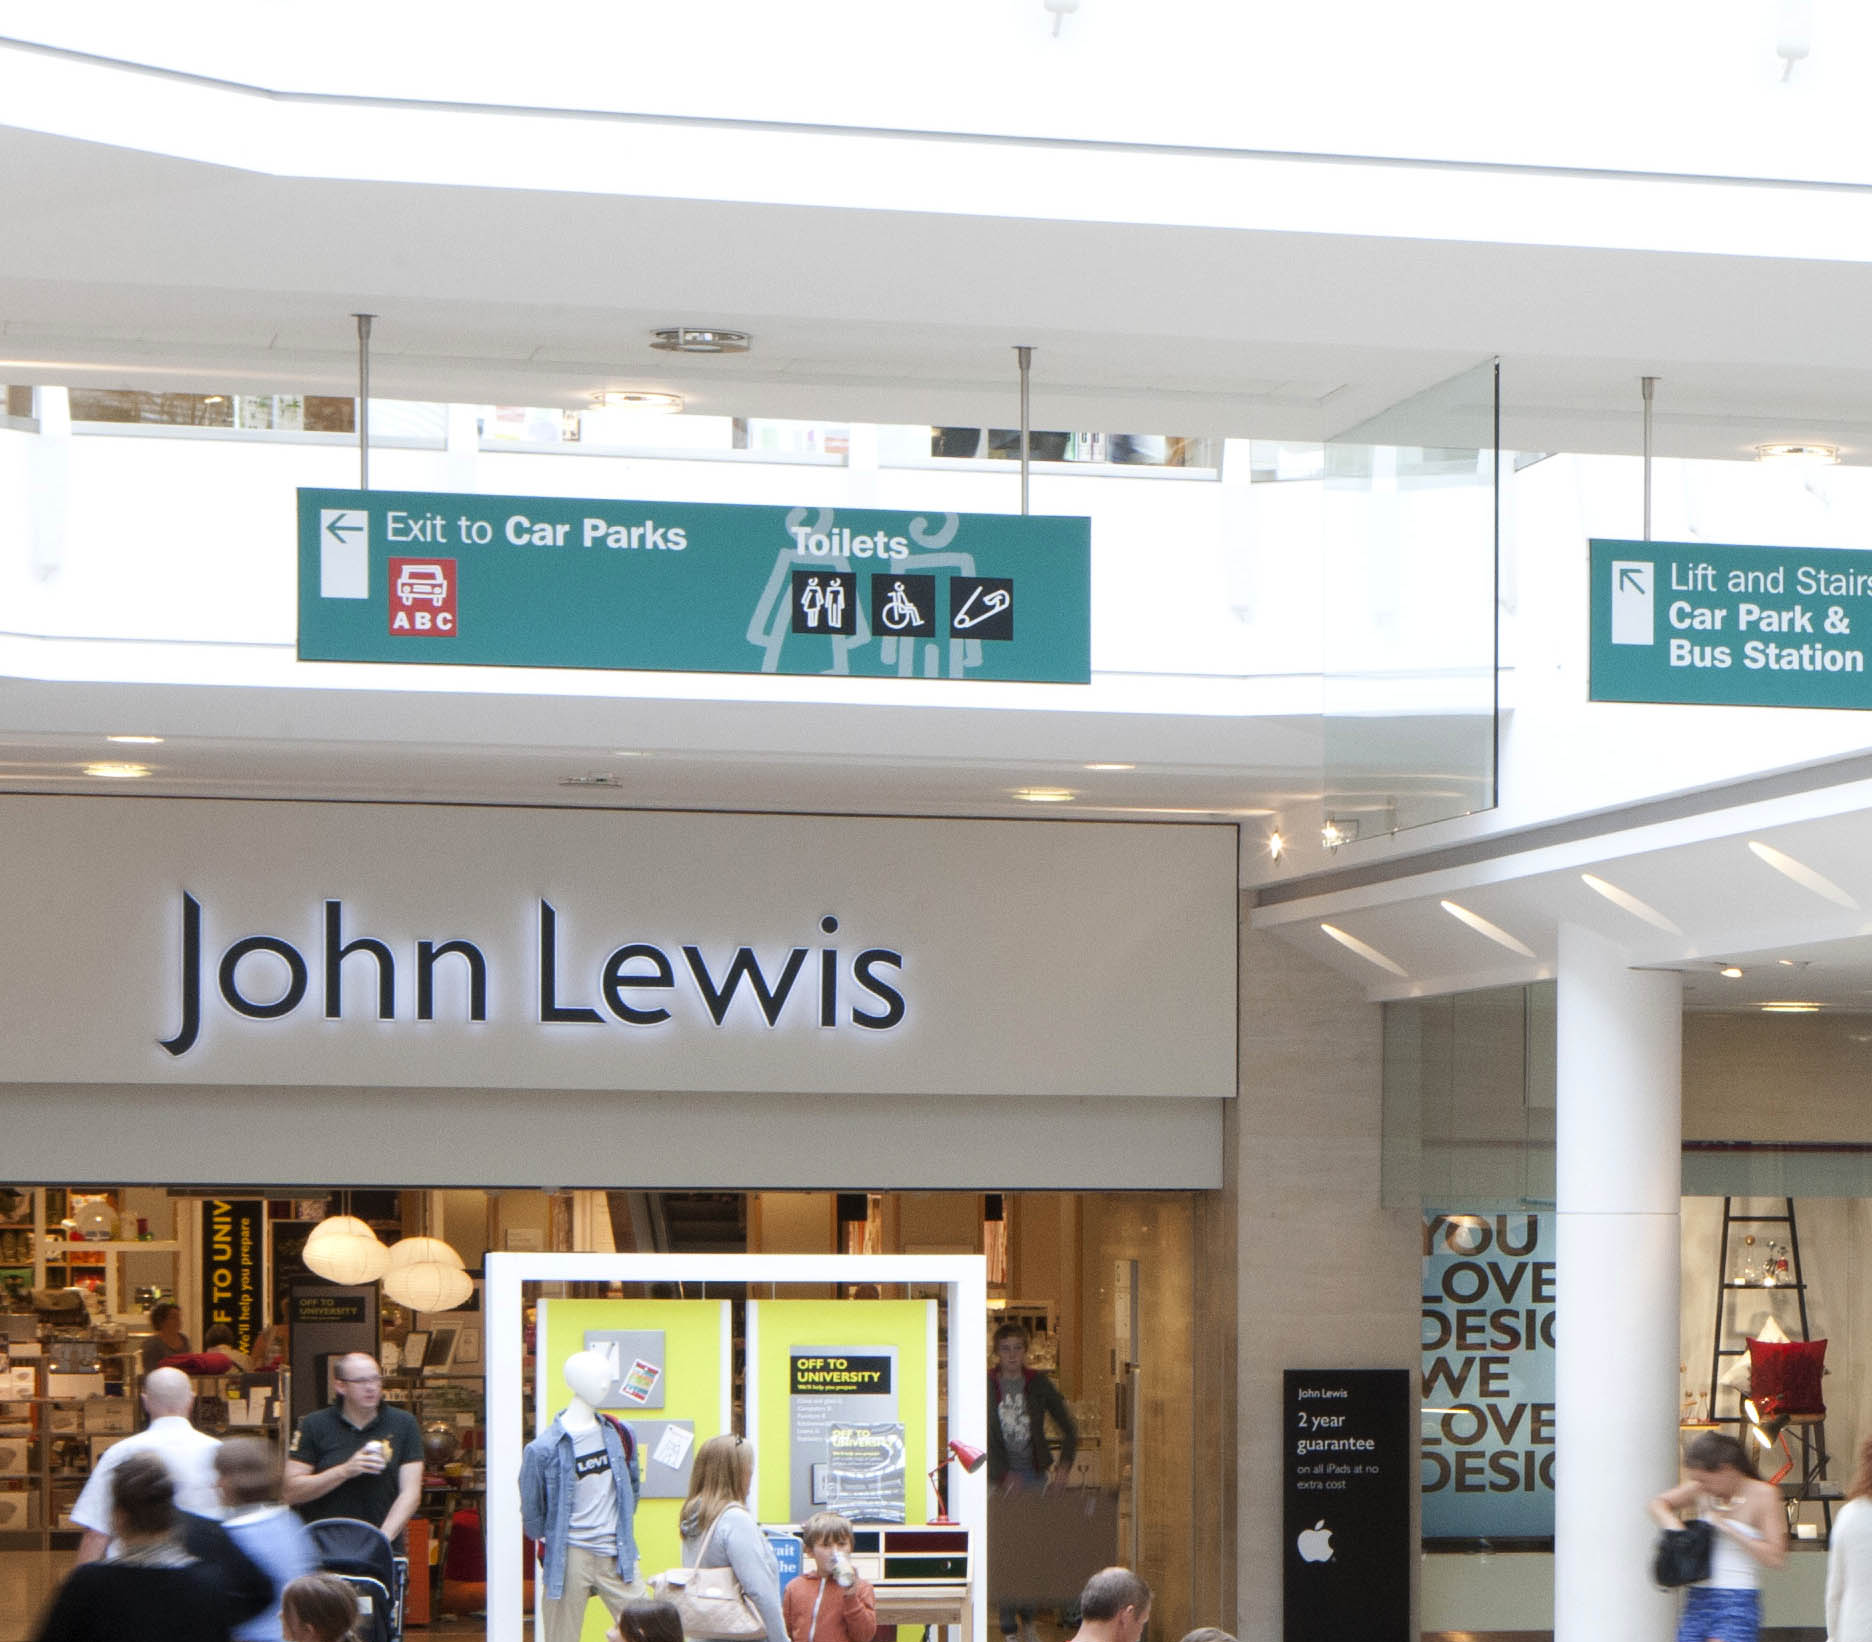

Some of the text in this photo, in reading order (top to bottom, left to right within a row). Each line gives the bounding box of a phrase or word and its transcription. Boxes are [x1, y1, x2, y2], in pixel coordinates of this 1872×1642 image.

[386, 511, 689, 553] Exit to Car Parks
[791, 526, 910, 561] Toilets
[1670, 562, 1717, 593] Lift
[1728, 566, 1783, 595] and
[1668, 603, 1851, 635] Car Park &
[1669, 638, 1864, 674] Bus Station
[156, 890, 907, 1057] John Lewis
[212, 1200, 232, 1261] UNIV
[1422, 1214, 1538, 1257] YOU
[212, 1269, 232, 1304] TO
[238, 1217, 253, 1355] We'll help you prepare
[797, 1358, 848, 1370] OFF TO
[797, 1371, 881, 1383] UNIVERSITY
[1422, 1356, 1510, 1399] WE
[1298, 1388, 1348, 1400] John Lewis
[1298, 1412, 1346, 1431] 2 year
[1297, 1437, 1375, 1455] guarantee
[577, 1454, 609, 1473] Levi
[1297, 1463, 1380, 1474] on all iPads at no
[1297, 1480, 1346, 1489] extra cost
